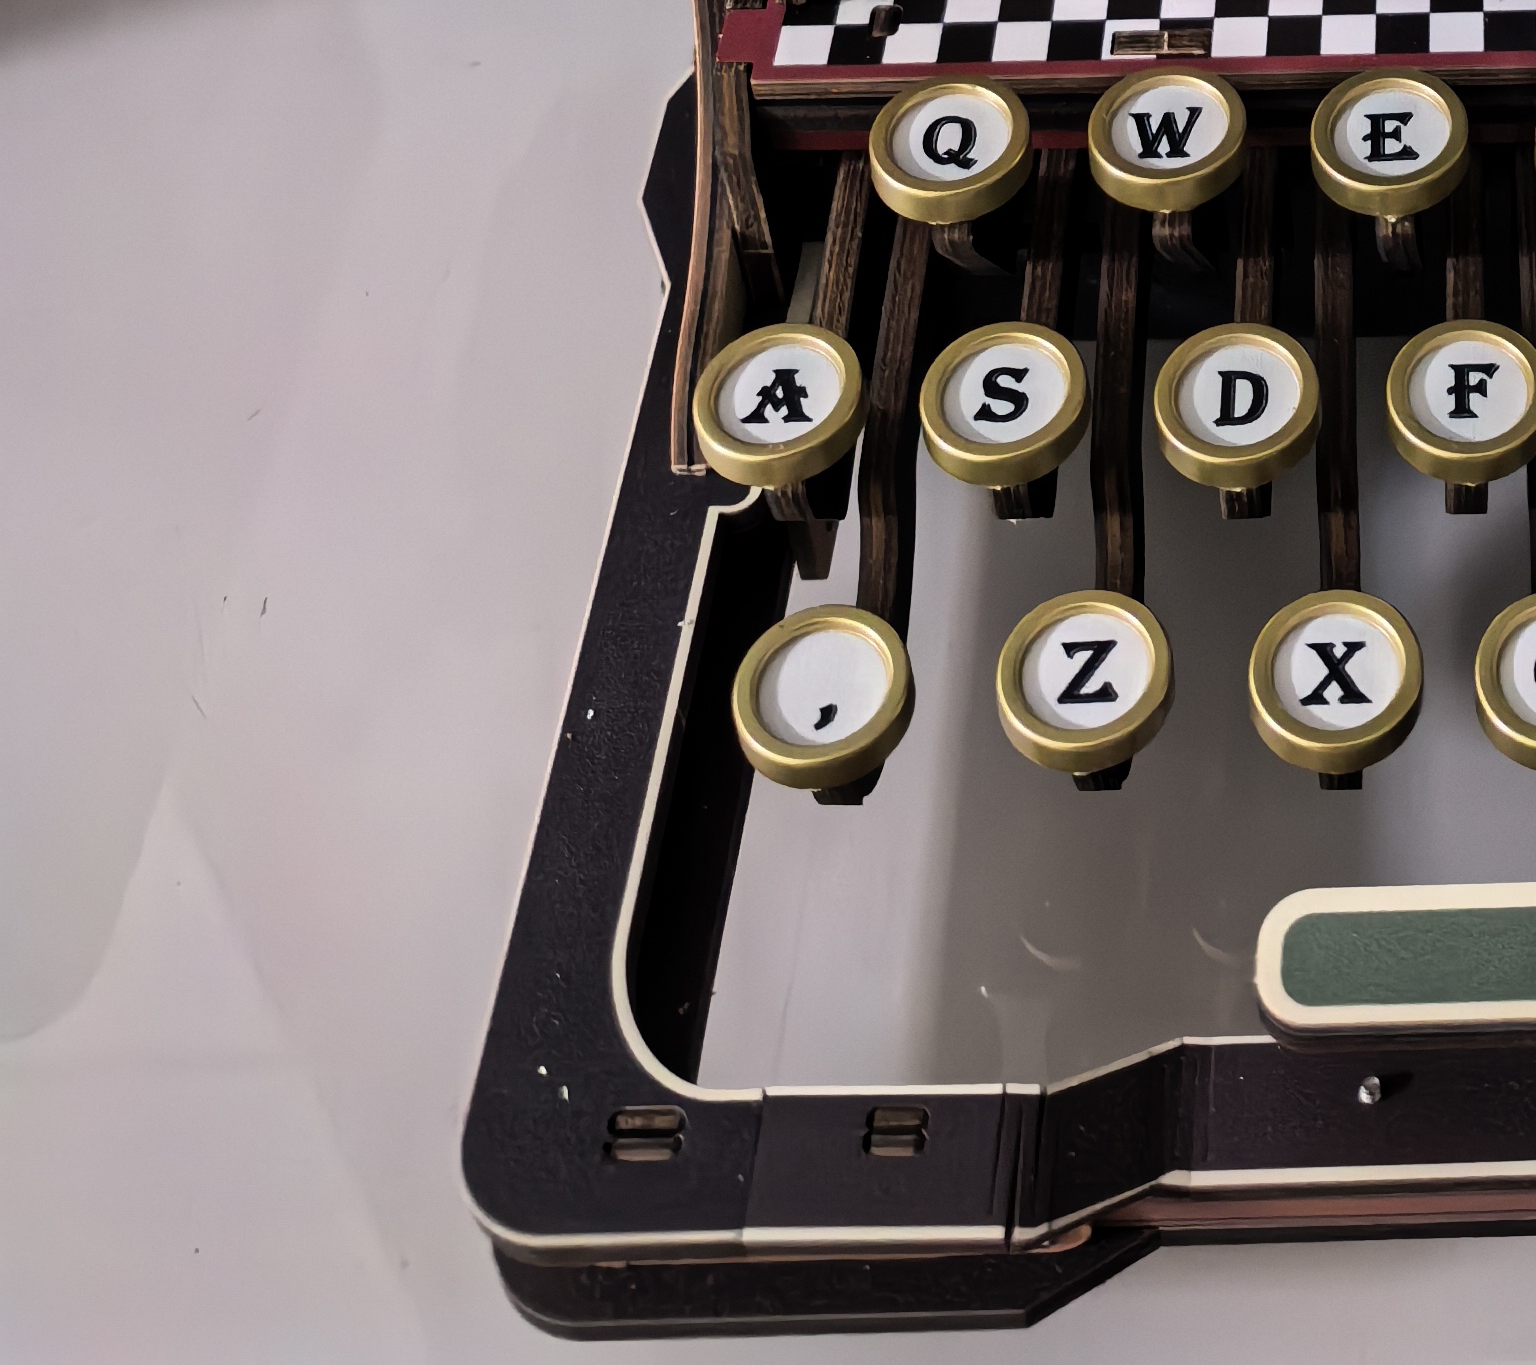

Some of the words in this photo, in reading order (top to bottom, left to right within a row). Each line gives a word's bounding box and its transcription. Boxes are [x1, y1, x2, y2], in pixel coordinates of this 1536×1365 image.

[922, 115, 979, 171] Q
[1128, 106, 1203, 160] W
[1361, 111, 1420, 163] E
[739, 368, 813, 424] A
[973, 366, 1030, 423] S
[1212, 370, 1269, 428] D
[1446, 362, 1500, 419] F
[1056, 639, 1119, 705] Z
[1298, 641, 1371, 707] X
